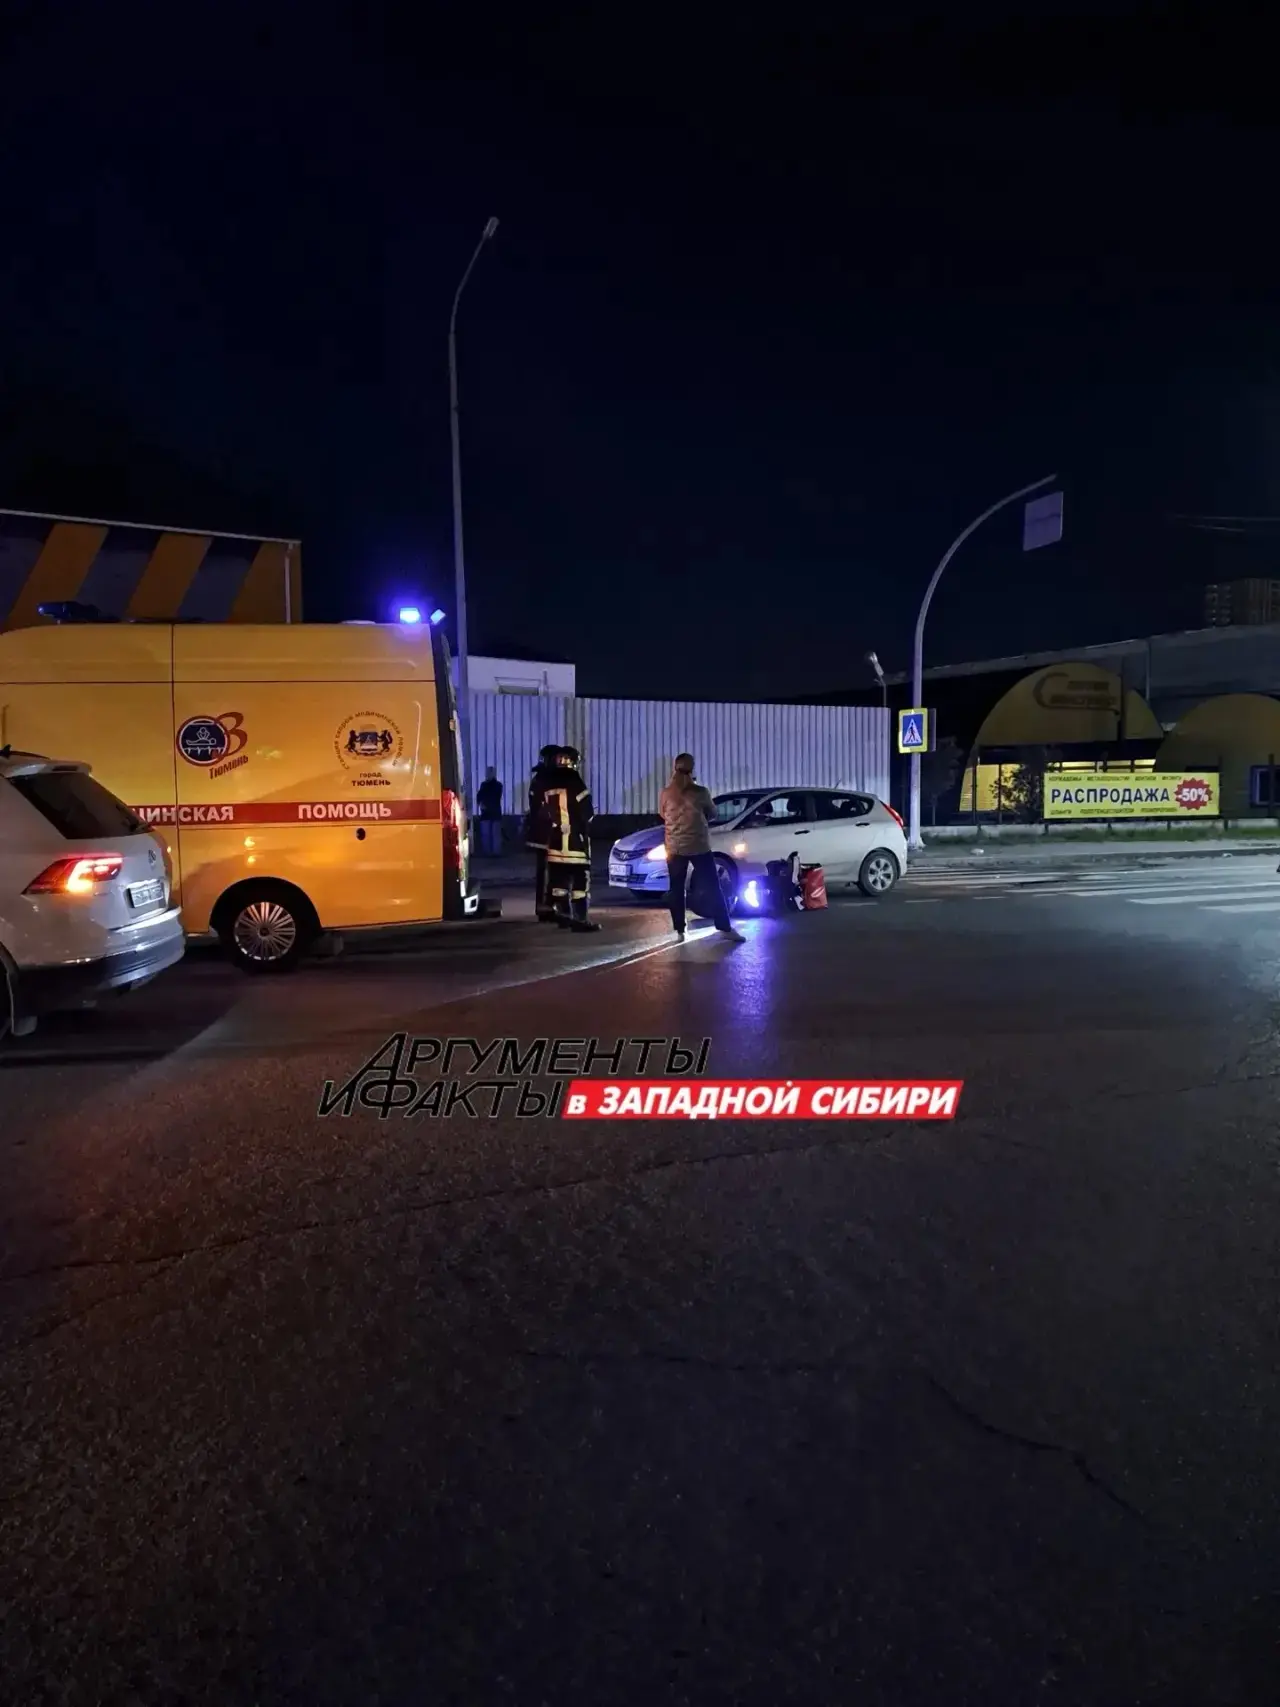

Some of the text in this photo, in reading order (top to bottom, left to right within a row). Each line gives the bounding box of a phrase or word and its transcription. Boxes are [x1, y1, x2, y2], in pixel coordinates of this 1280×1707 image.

[351, 779, 391, 787] ТЮМЕНЬ
[1051, 787, 1170, 806] РАСПРОДАЖА
[1177, 787, 1209, 802] -50%
[298, 802, 392, 820] ПОМОЩЬ
